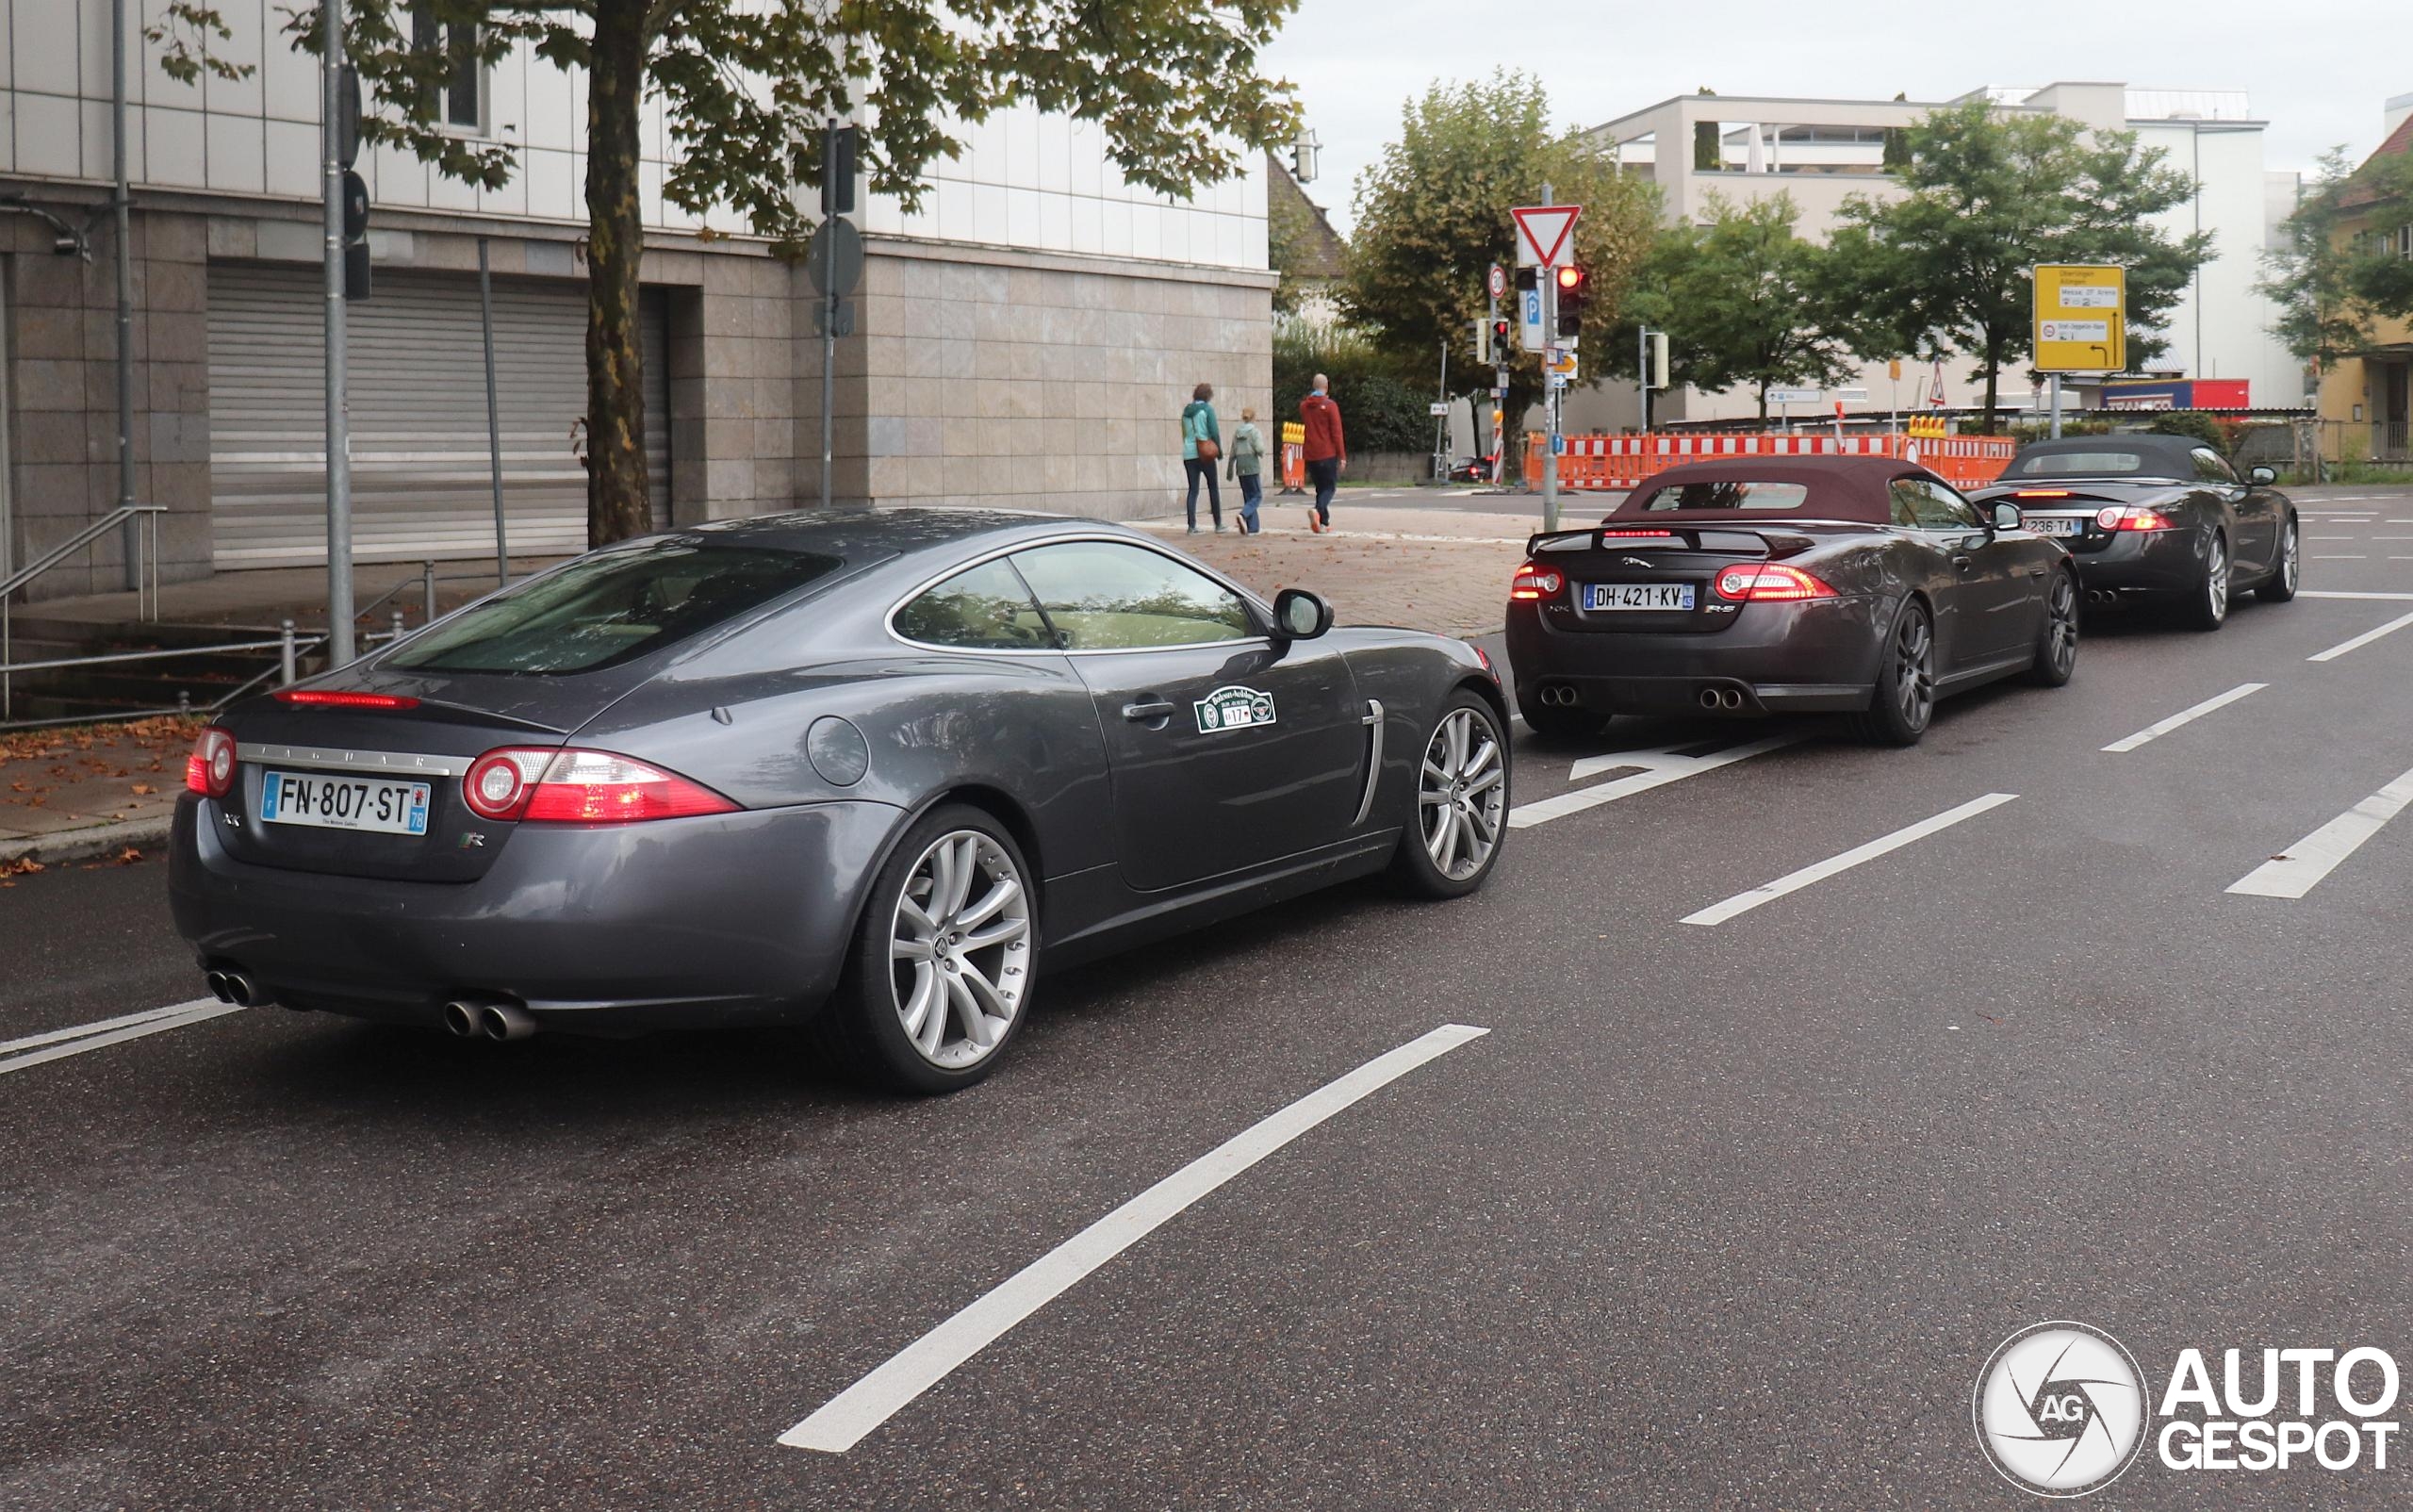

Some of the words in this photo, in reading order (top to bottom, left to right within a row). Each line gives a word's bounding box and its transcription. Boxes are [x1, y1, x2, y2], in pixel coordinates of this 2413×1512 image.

[1493, 274, 1502, 289] 30
[1529, 302, 1538, 320] P
[1597, 587, 1681, 606] DH-421-KV
[1683, 597, 1693, 606] 45
[1232, 709, 1241, 722] 17
[262, 747, 424, 767] JAGUAR
[267, 800, 272, 810] F
[280, 779, 411, 823] FN-807-ST
[411, 812, 423, 829] 78
[222, 813, 240, 828] XK
